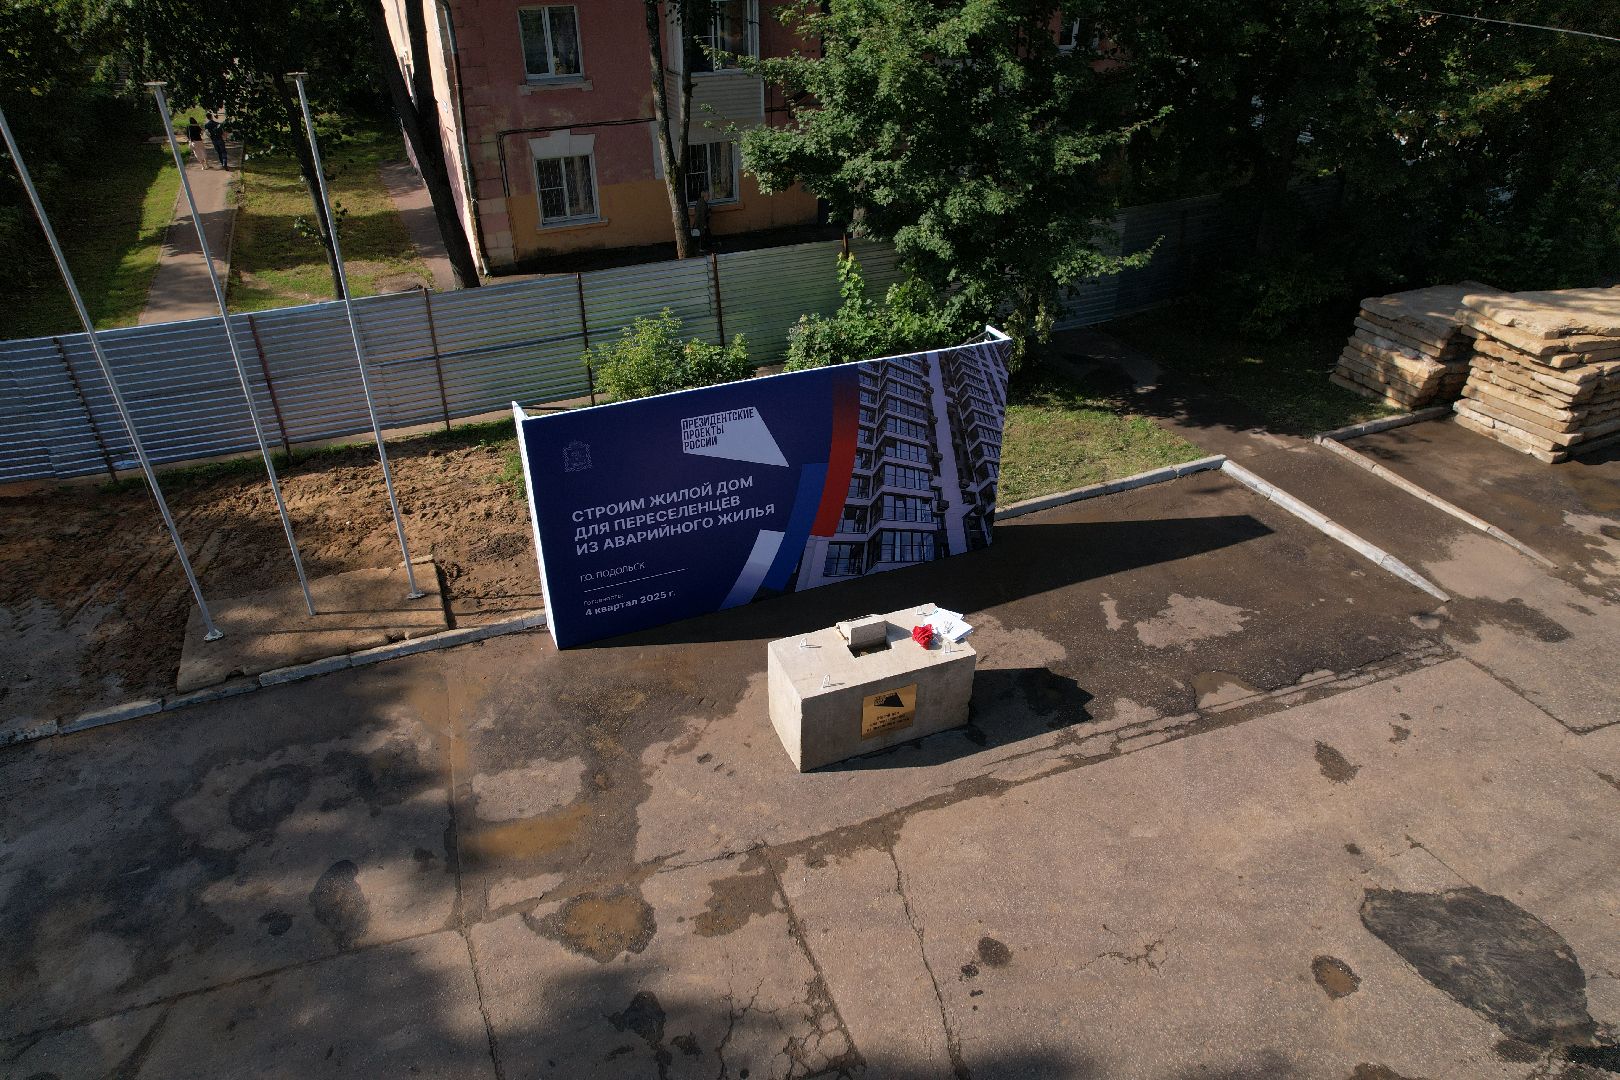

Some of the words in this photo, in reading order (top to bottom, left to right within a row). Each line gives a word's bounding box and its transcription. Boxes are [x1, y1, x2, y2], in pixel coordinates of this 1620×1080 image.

[682, 408, 755, 430] ПРЕЗИДЕНТСКИЕ
[683, 424, 724, 441] ПРОЕКТЫ
[684, 436, 718, 451] РОССИИ
[571, 497, 645, 523] СТРОИМ
[649, 481, 714, 508] ЖИЛОЙ
[716, 475, 754, 496] ДОМ
[574, 520, 610, 542] ДЛЯ
[613, 495, 741, 531] ПЕРЕСЕЛЕНЦЕВ
[576, 538, 599, 556] ИЗ
[603, 515, 714, 550] АВАРИЙНОГО
[717, 503, 775, 527] ЖИЛЬЯ
[596, 561, 646, 579] ПОДОЛЬСК
[585, 608, 593, 616] 4
[594, 599, 638, 616] квартал
[639, 590, 667, 604] 2025
